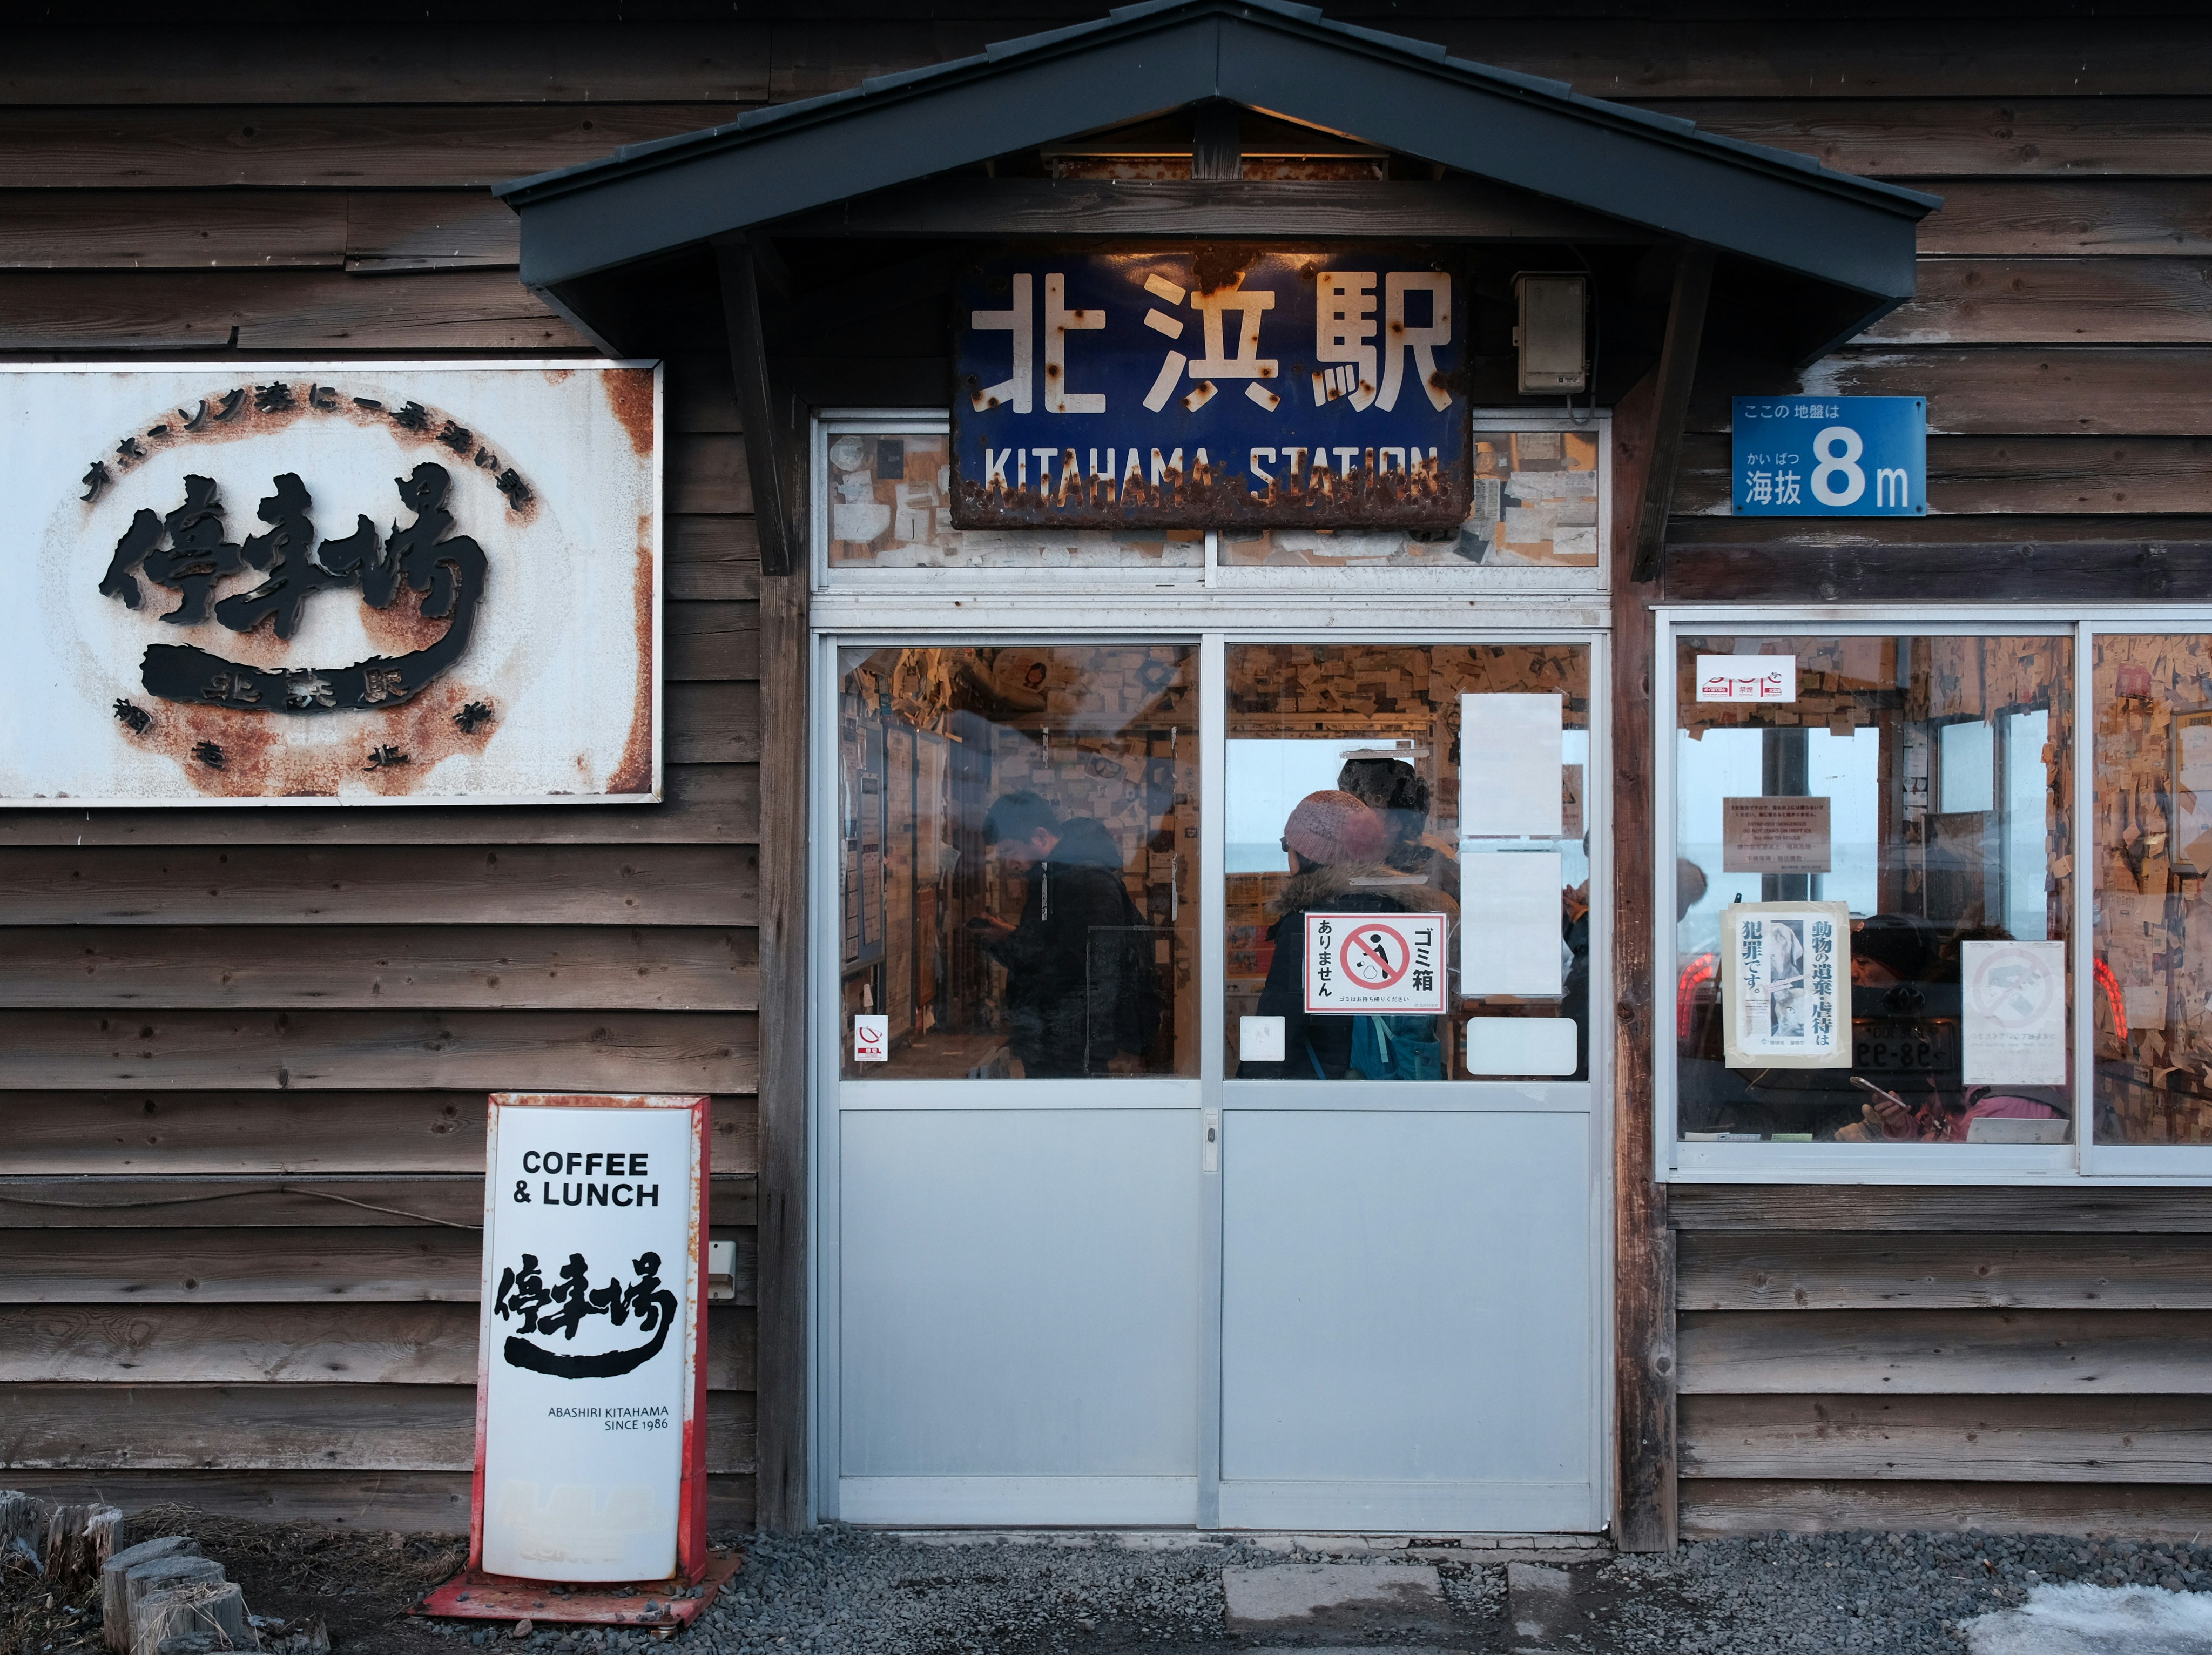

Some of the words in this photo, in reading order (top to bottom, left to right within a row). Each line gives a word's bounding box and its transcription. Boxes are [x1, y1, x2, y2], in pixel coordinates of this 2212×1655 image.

[970, 271, 1453, 413] 北浜駅
[984, 447, 1213, 508] KITAHAMA
[1249, 447, 1439, 508] STATION
[1745, 470, 1801, 506] 海抜
[1810, 426, 1865, 507] 8
[1877, 468, 1908, 507] m
[1318, 920, 1333, 997] ありません
[1412, 927, 1434, 992] ゴミ箱
[1741, 920, 1763, 994] 犯罪です。
[1811, 921, 1833, 1046] 動物の遺棄・虐待は
[514, 1180, 532, 1203] &
[543, 1181, 659, 1207] LUNCH
[523, 1151, 648, 1176] COFFEE
[494, 1251, 678, 1380] 停車場
[548, 1408, 601, 1418] ABASHIRI
[604, 1405, 669, 1418] KITAHAMA
[604, 1419, 638, 1431] SINCE
[641, 1419, 669, 1431] 1986
